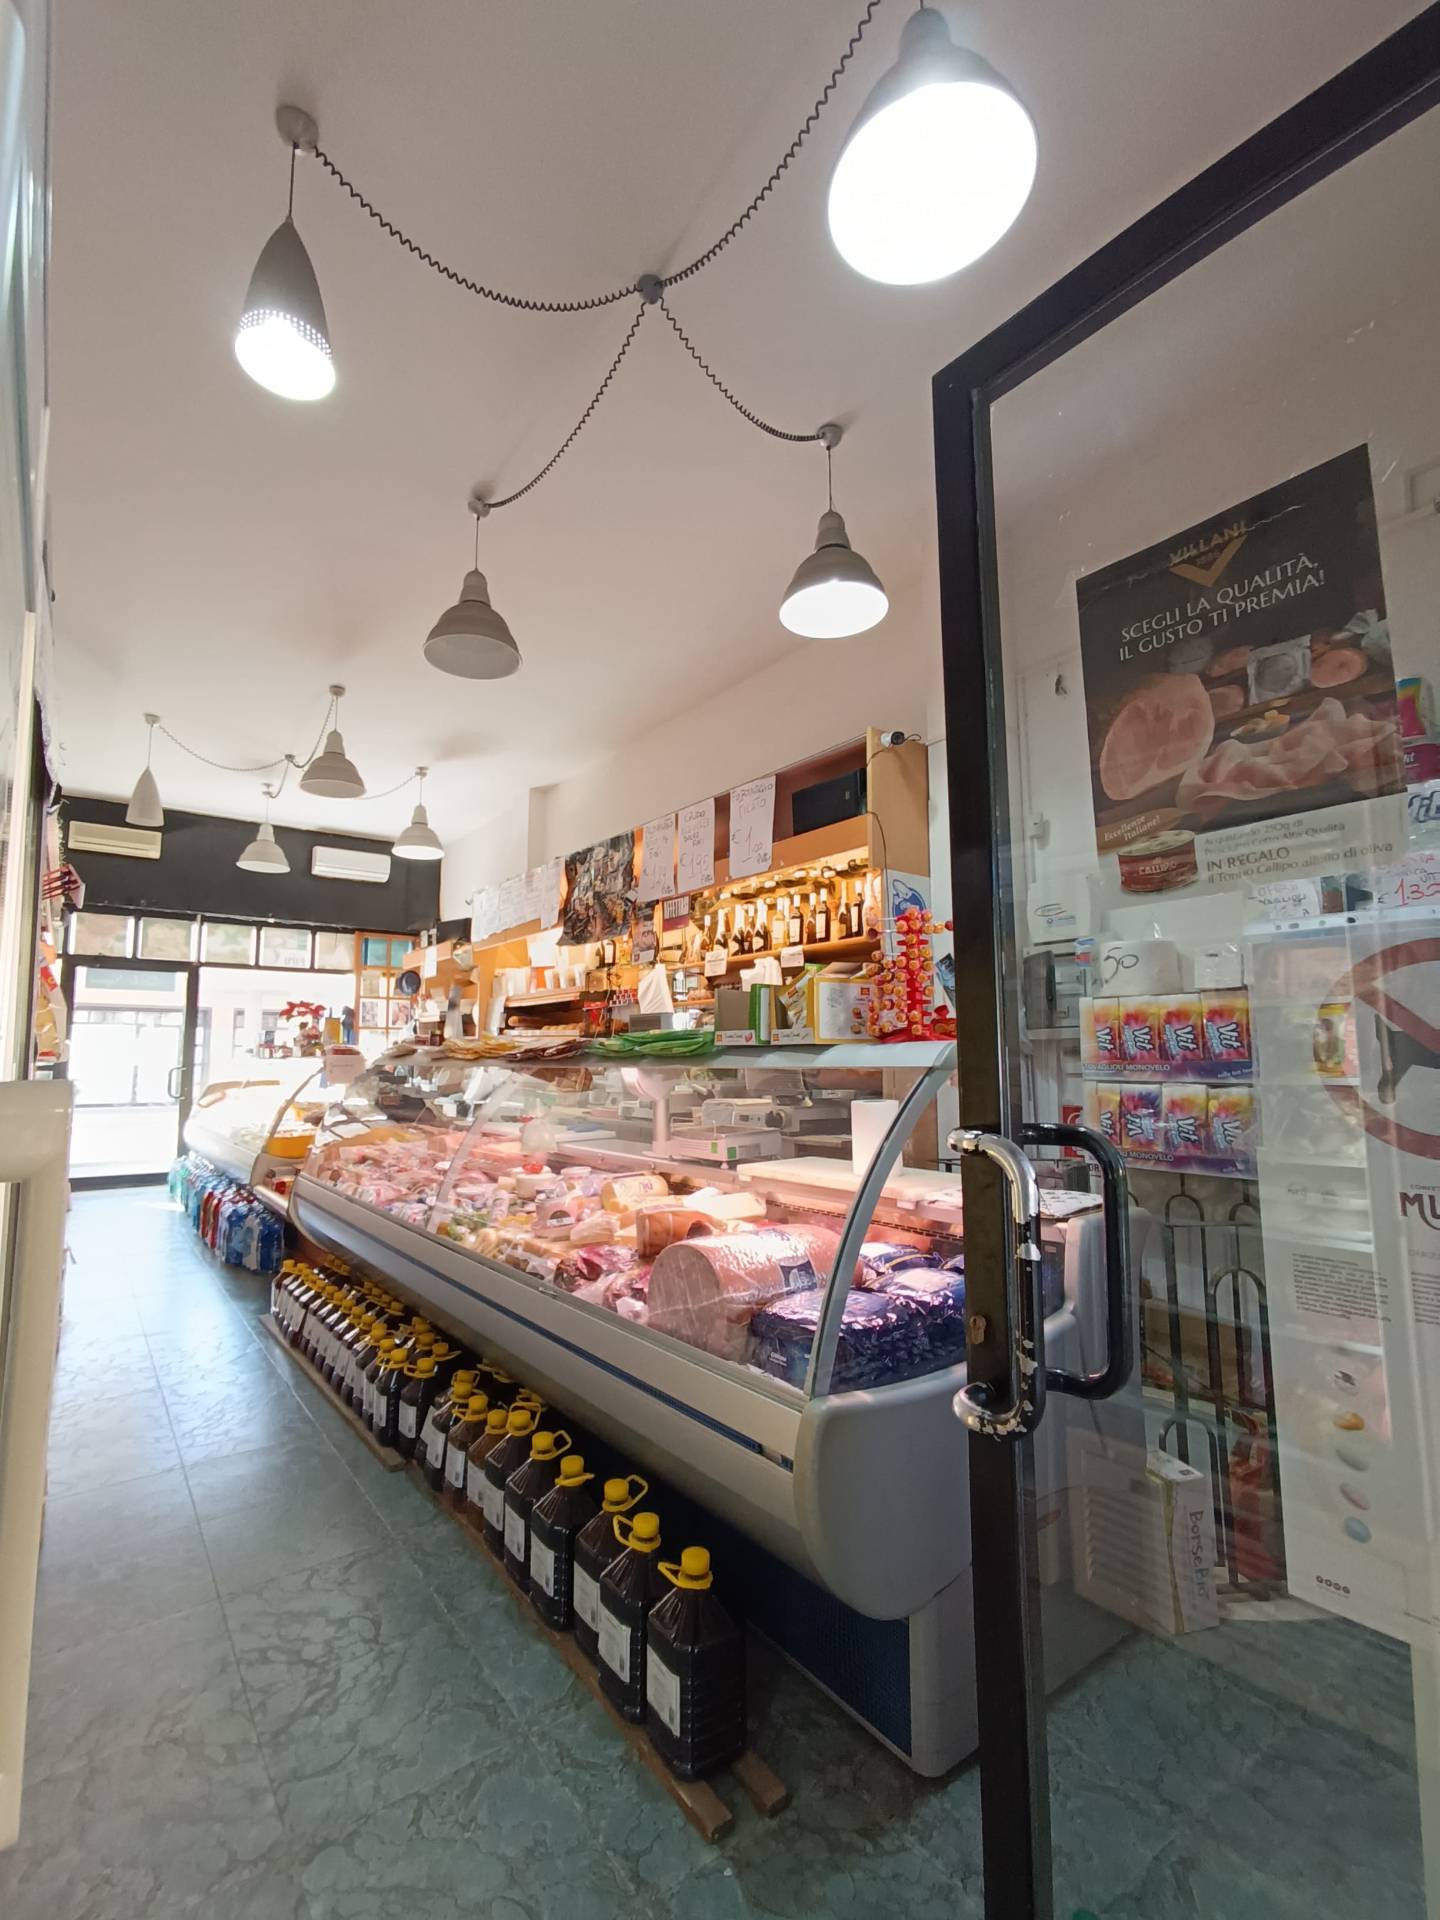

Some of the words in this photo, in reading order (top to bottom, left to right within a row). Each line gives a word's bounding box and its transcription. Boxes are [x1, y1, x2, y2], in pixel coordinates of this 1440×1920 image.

[1168, 521, 1248, 567] VILLANI
[1119, 646, 1134, 661] IL
[1138, 619, 1203, 653] GUSTO
[1208, 609, 1228, 626] TI
[1235, 569, 1325, 618] PREMIA!
[1121, 608, 1180, 642] SCEGLI
[1187, 598, 1211, 616] LA
[1124, 815, 1160, 841] Italiane!
[1293, 820, 1303, 828] di
[1207, 861, 1222, 872] IN
[1227, 847, 1290, 868] REGALO
[1217, 868, 1254, 882] Tonno
[1256, 861, 1298, 874] Callipo
[1343, 847, 1357, 859] di
[1360, 842, 1393, 857] oliva
[1104, 947, 1139, 983] 50
[1096, 1026, 1114, 1052] Vit
[1133, 1025, 1155, 1052] Vit
[1174, 1024, 1197, 1052] Vit
[1217, 1022, 1242, 1050] Vit
[1100, 1111, 1114, 1136] Vit
[1177, 1116, 1201, 1144] Vit
[1130, 1151, 1174, 1162] MONOVELO
